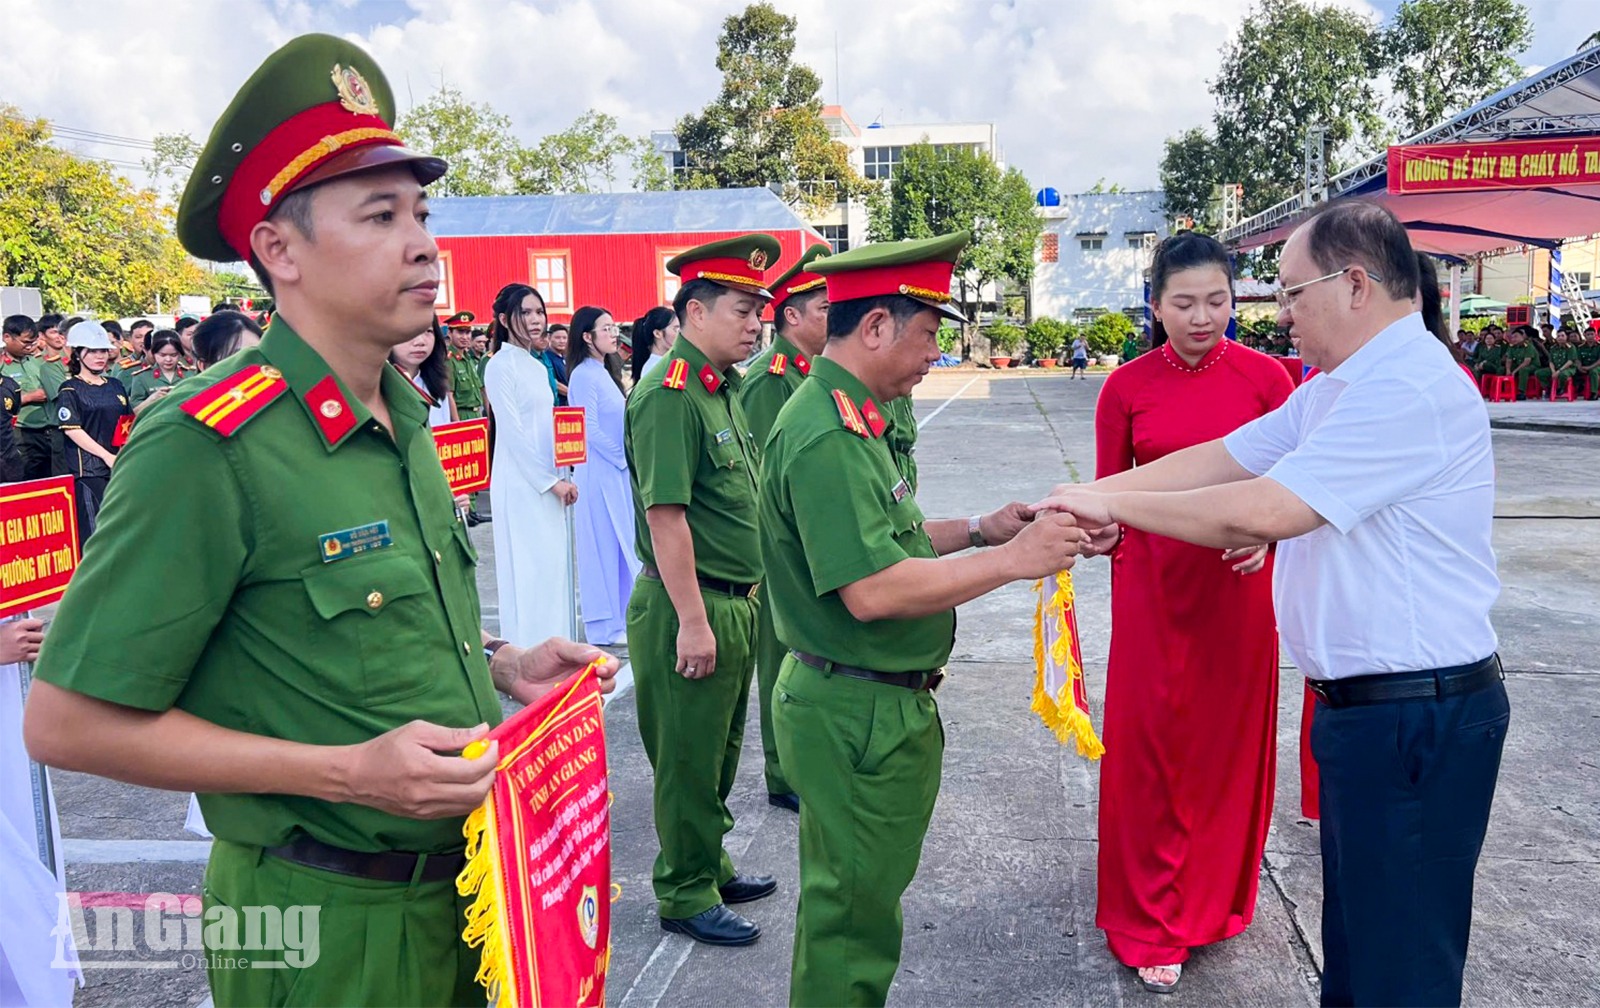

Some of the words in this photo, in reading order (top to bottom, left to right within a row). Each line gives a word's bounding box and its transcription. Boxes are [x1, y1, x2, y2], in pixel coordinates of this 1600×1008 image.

[1405, 156, 1450, 182] KHÔNG
[1452, 150, 1470, 180] ĐỂ
[1499, 156, 1516, 178] RA
[1520, 151, 1556, 178] CHÁY,
[1558, 144, 1580, 176] NỔ,
[6, 518, 25, 544] GIA
[26, 514, 40, 540] AN
[40, 506, 65, 536] TOÀN
[0, 555, 36, 589] HƯỜNG
[36, 549, 51, 579] MỸ
[525, 752, 546, 782] BAN
[545, 731, 573, 764] NHÂN
[572, 714, 599, 742] DÂN
[560, 746, 597, 782] GIANG
